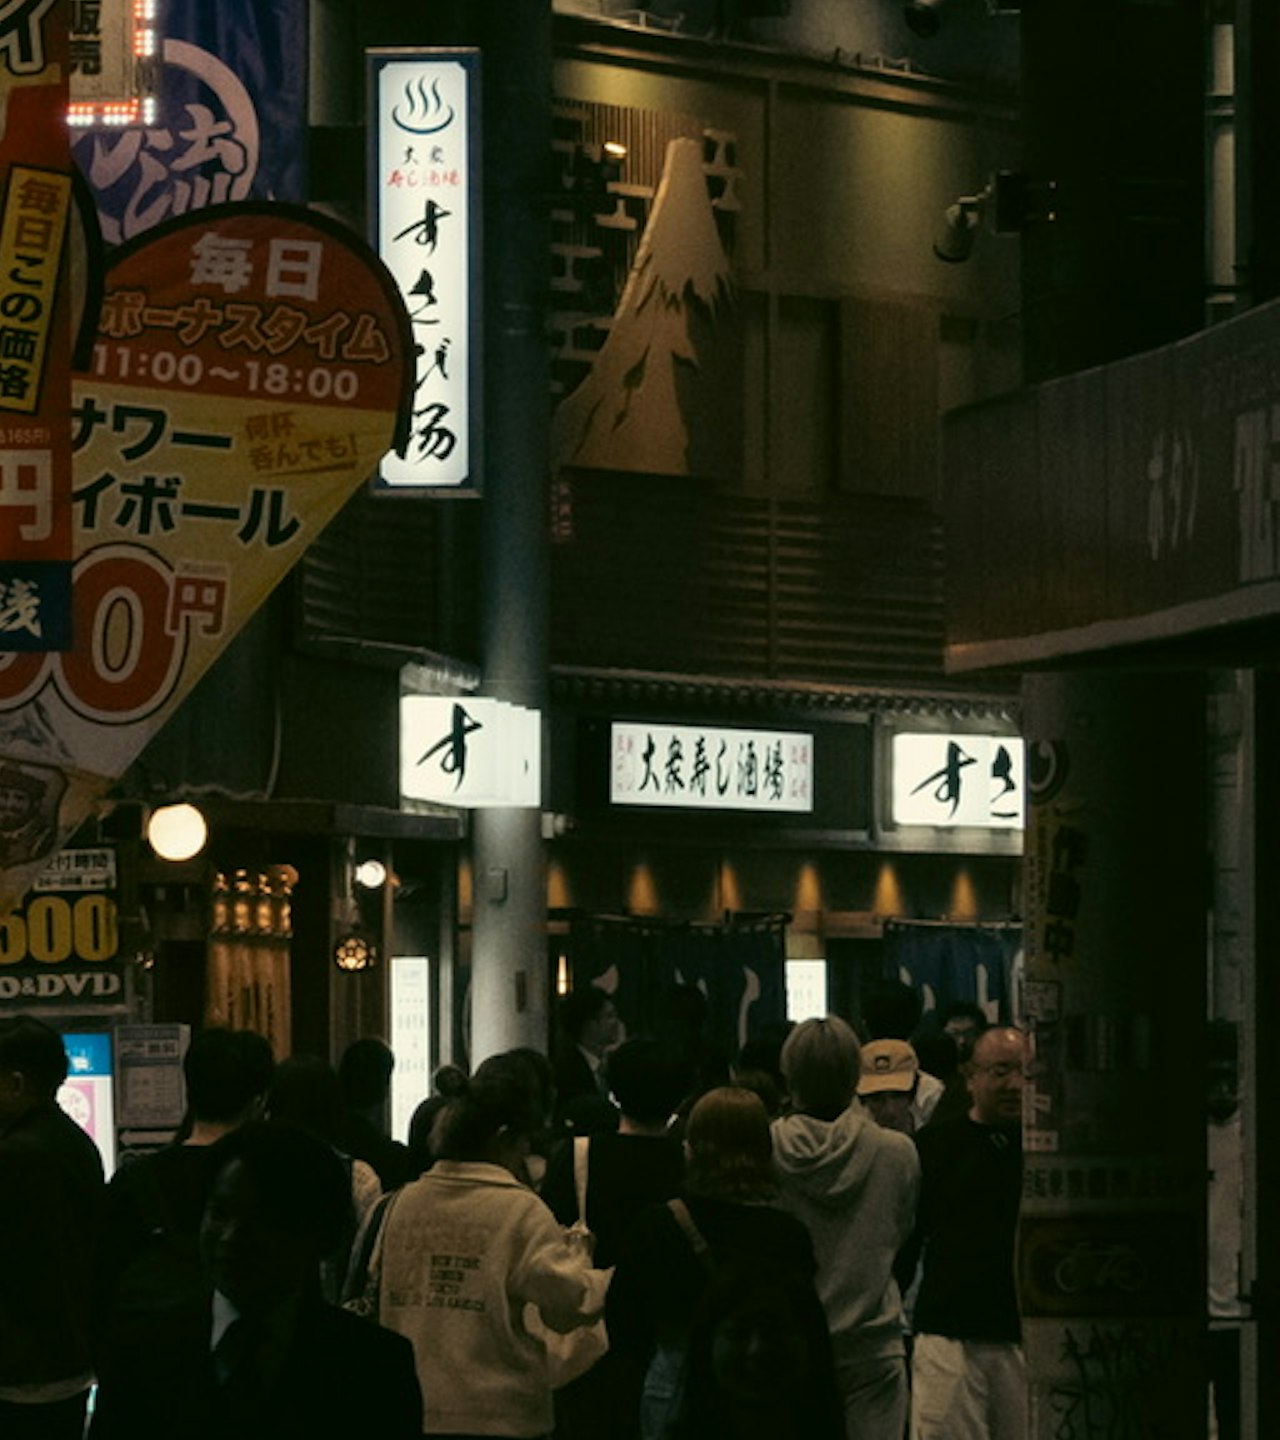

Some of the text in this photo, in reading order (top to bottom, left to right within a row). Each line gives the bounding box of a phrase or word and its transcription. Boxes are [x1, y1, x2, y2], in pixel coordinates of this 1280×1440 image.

[189, 232, 325, 302] 毎日
[98, 288, 391, 365] ボーナスタイム
[72, 473, 301, 548] イボール
